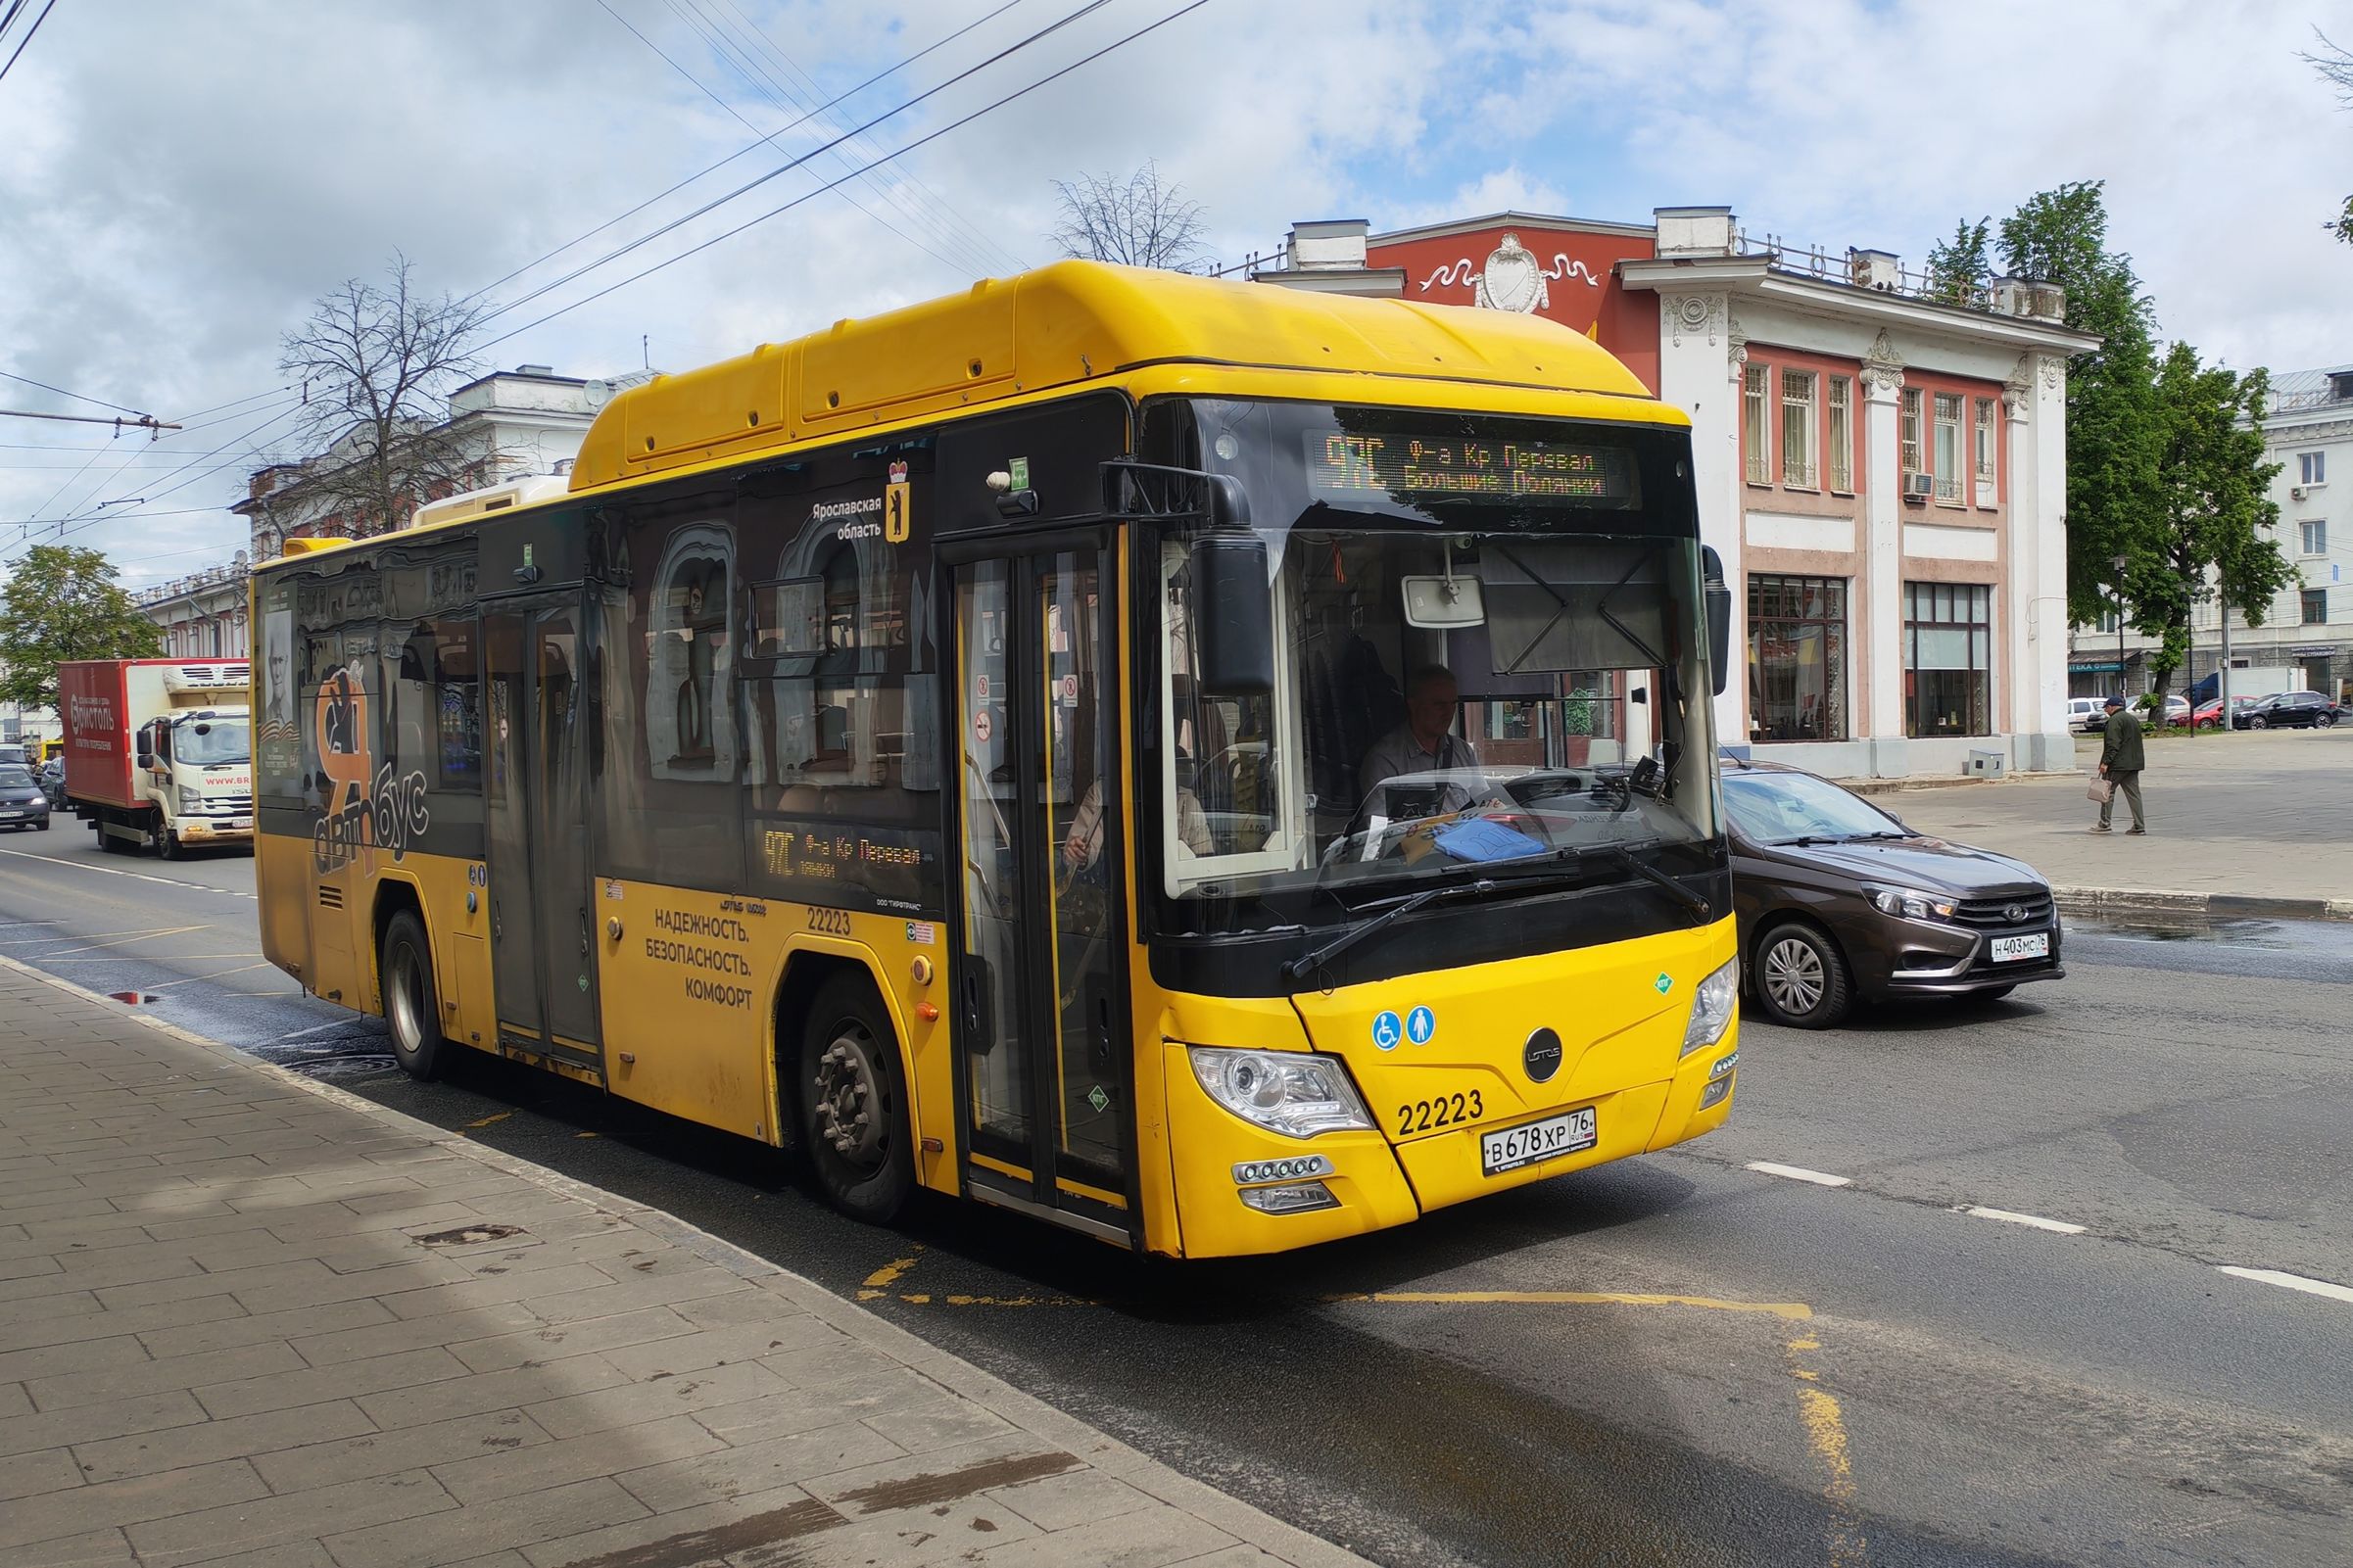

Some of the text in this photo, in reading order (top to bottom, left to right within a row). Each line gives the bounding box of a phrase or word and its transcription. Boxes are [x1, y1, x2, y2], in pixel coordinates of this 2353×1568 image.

[1504, 445, 1594, 470] Перевал
[1404, 465, 1602, 496] Большие Полянки
[813, 498, 882, 521] Ярославская
[838, 522, 881, 541] область
[859, 838, 921, 865] Перевал
[655, 909, 749, 942] НАДЕЖНОСТЬ.
[807, 907, 850, 935] 22223
[646, 938, 751, 976] БЕЗОПАСНОСТЬ.
[685, 977, 752, 1010] КОМФОРТ
[1398, 1089, 1483, 1136] 22223
[1571, 1113, 1588, 1134] 76
[1570, 1132, 1584, 1142] RUS
